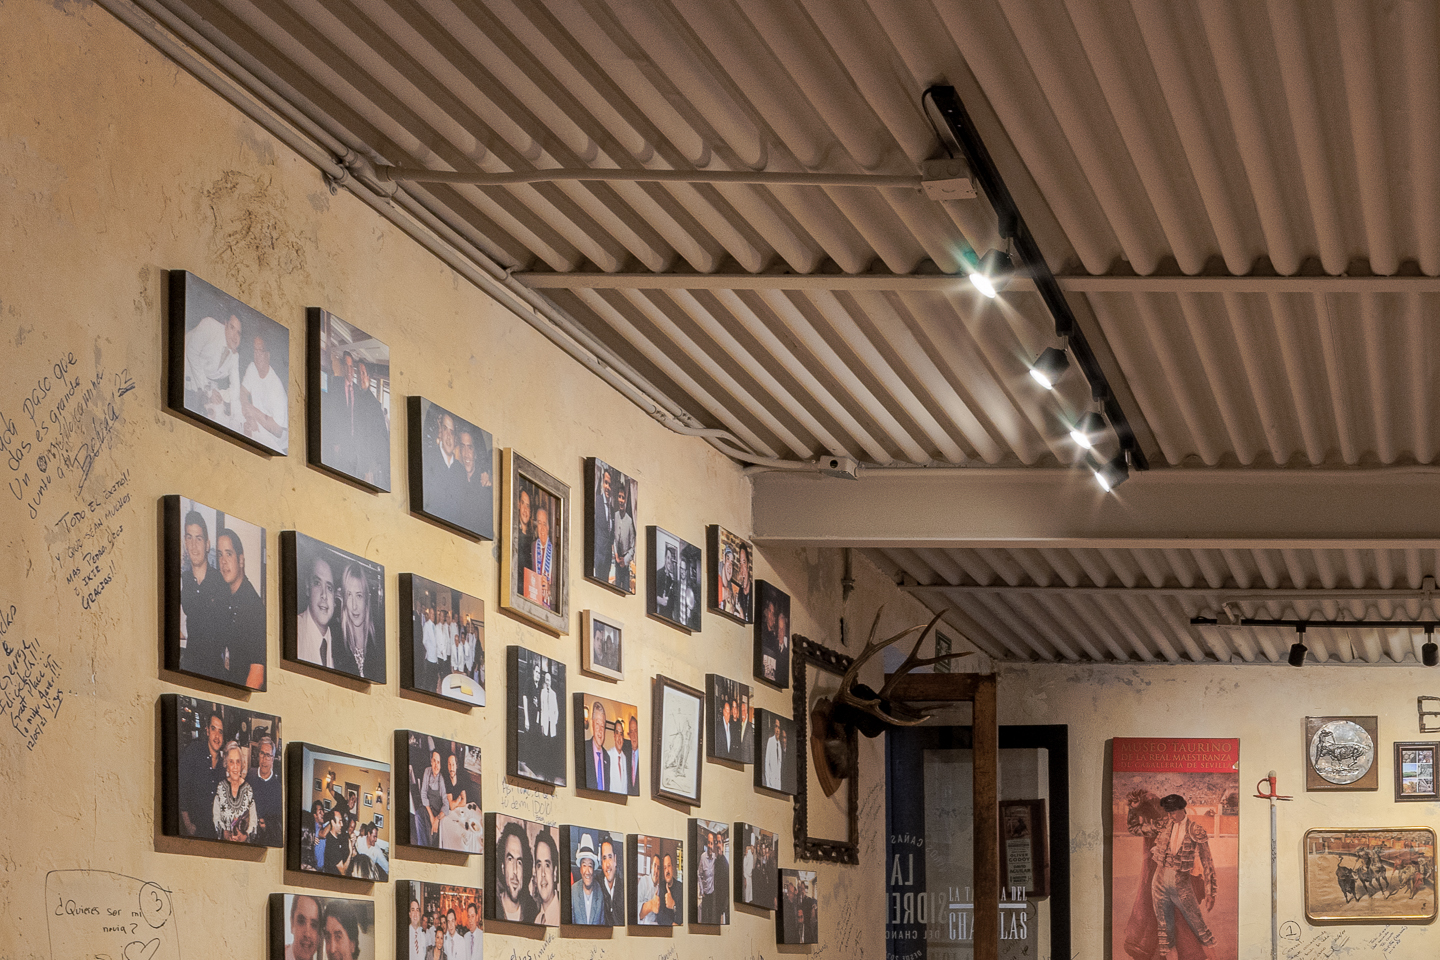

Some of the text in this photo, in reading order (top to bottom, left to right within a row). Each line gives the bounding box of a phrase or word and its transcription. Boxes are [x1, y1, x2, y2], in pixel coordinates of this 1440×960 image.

[36, 420, 49, 443] es
[87, 499, 101, 513] EL
[1121, 743, 1232, 753] MUSEO TAURINO
[150, 891, 163, 912] 3
[948, 886, 960, 902] LA
[1010, 886, 1028, 902] DEL
